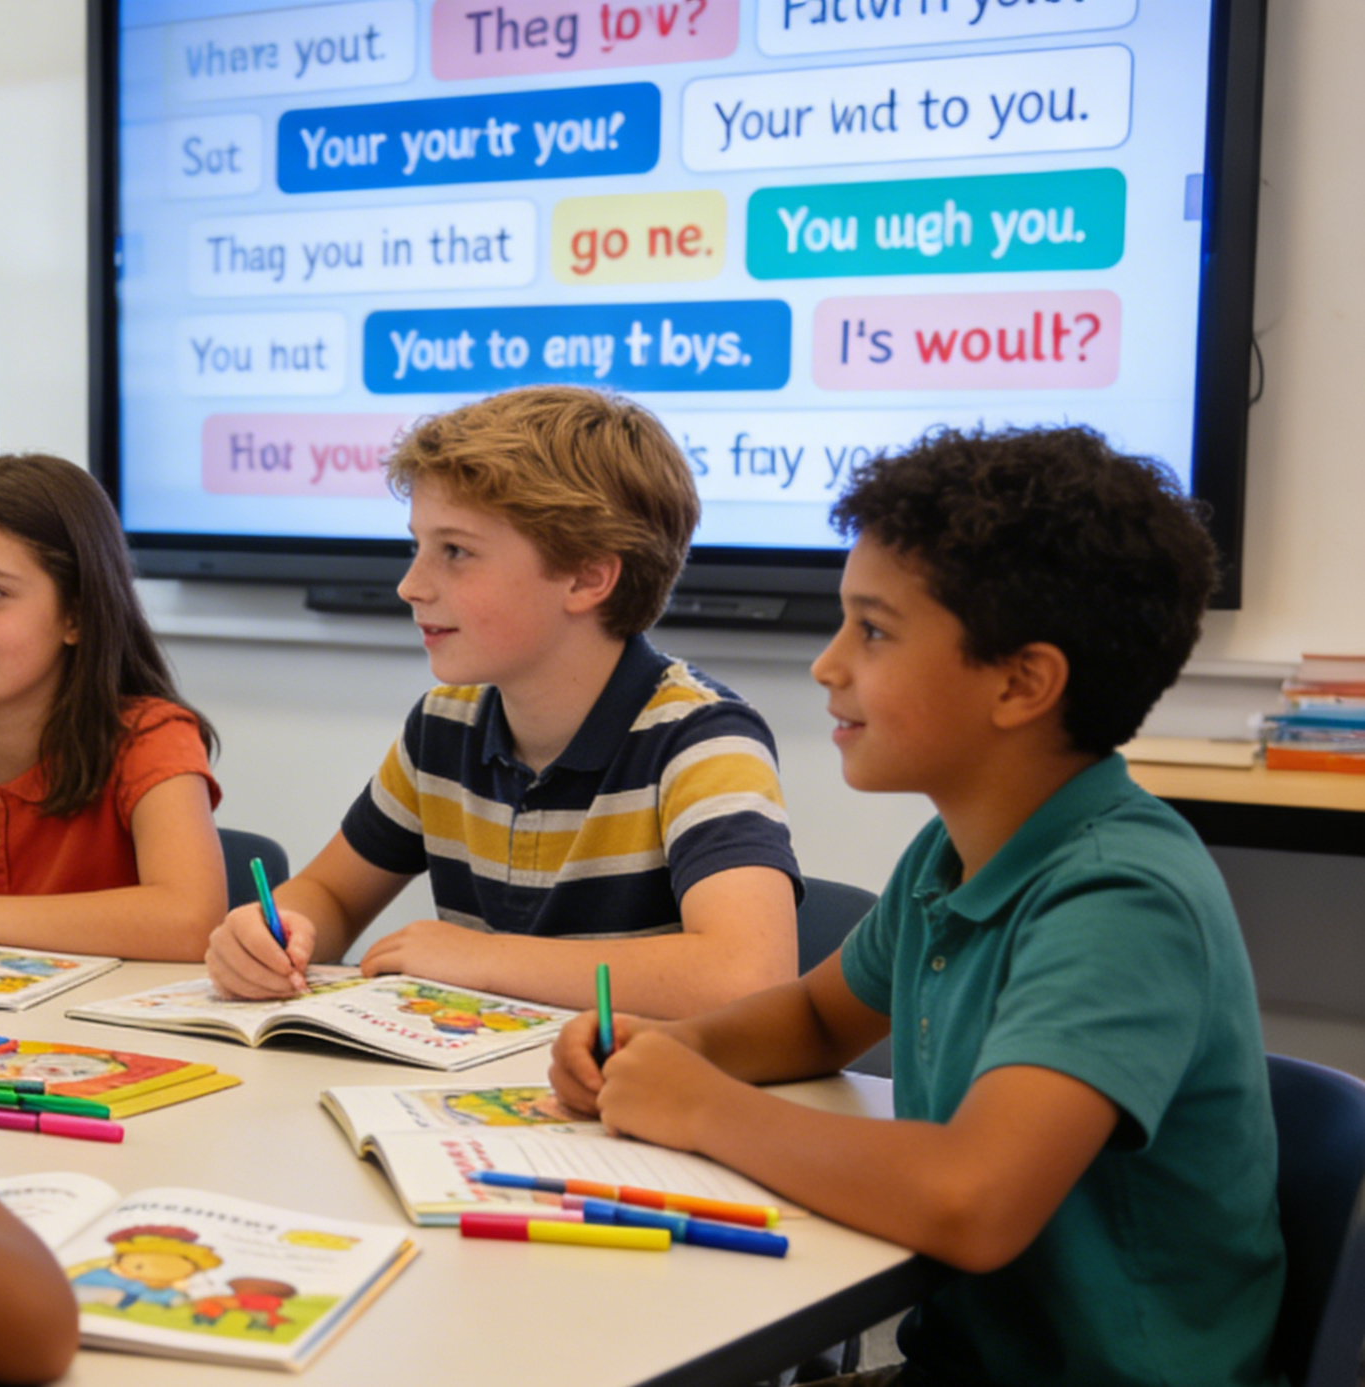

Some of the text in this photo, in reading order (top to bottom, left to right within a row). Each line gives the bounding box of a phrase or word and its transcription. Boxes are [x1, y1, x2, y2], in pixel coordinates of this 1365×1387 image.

[714, 101, 814, 152] Your
[918, 90, 970, 131] to
[988, 87, 1089, 140] you.
[300, 126, 387, 170] Your
[302, 241, 364, 282] you
[381, 229, 412, 266] in
[429, 225, 512, 265] that
[570, 224, 713, 276] go ne.
[777, 205, 858, 254] You
[990, 207, 1086, 260] you.
[190, 336, 252, 375] You
[390, 329, 476, 380] Yout
[487, 330, 530, 369] to
